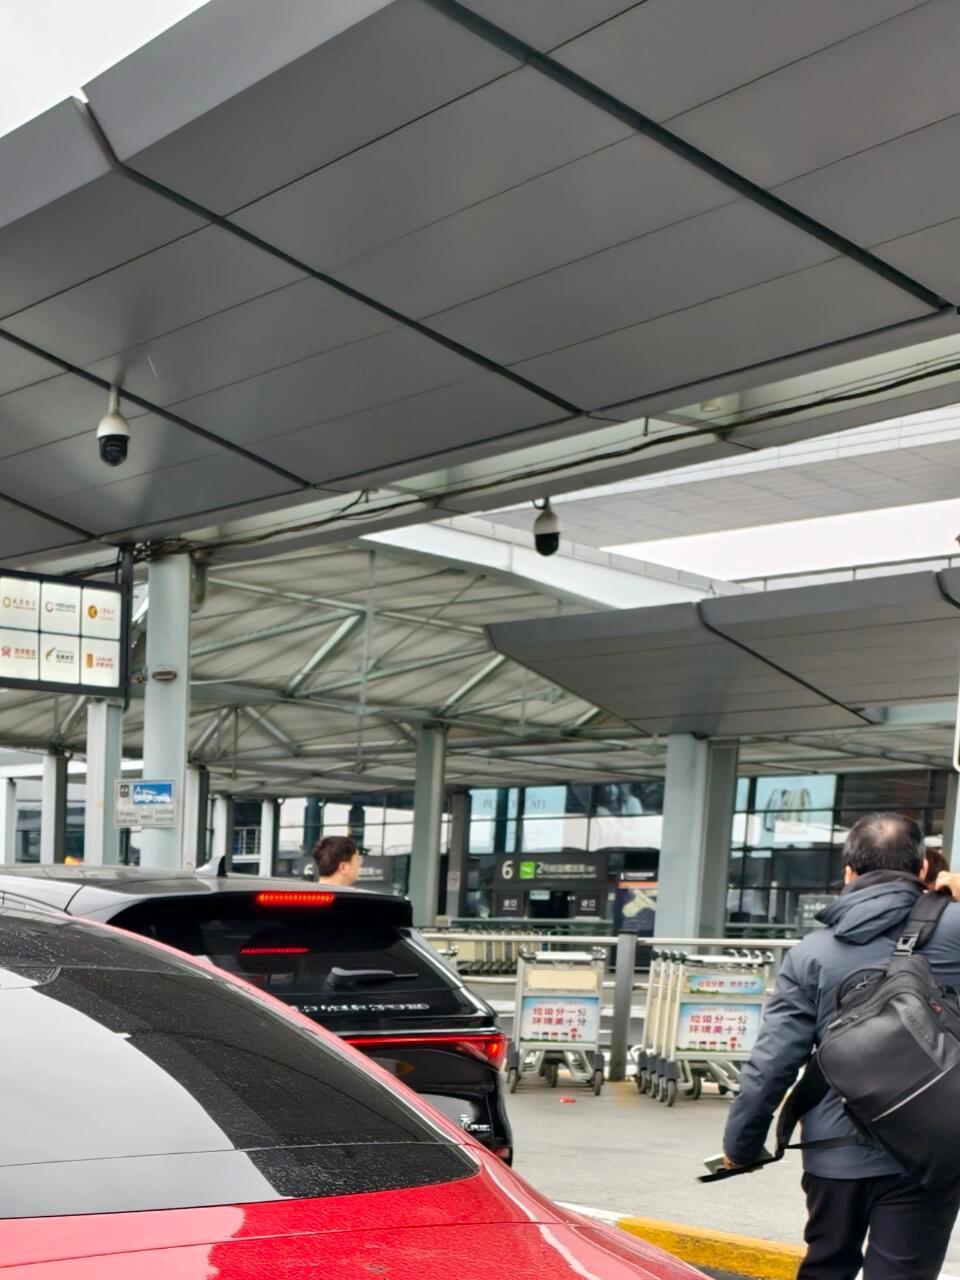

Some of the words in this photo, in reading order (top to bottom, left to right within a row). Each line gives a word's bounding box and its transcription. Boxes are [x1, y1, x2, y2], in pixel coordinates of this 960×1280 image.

[501, 860, 514, 879] 6
[532, 1007, 587, 1017] 垃圾分一分
[532, 1017, 586, 1026] 环境美十分
[690, 1014, 748, 1025] 垃圾分一分
[689, 1025, 747, 1035] 环境美十分
